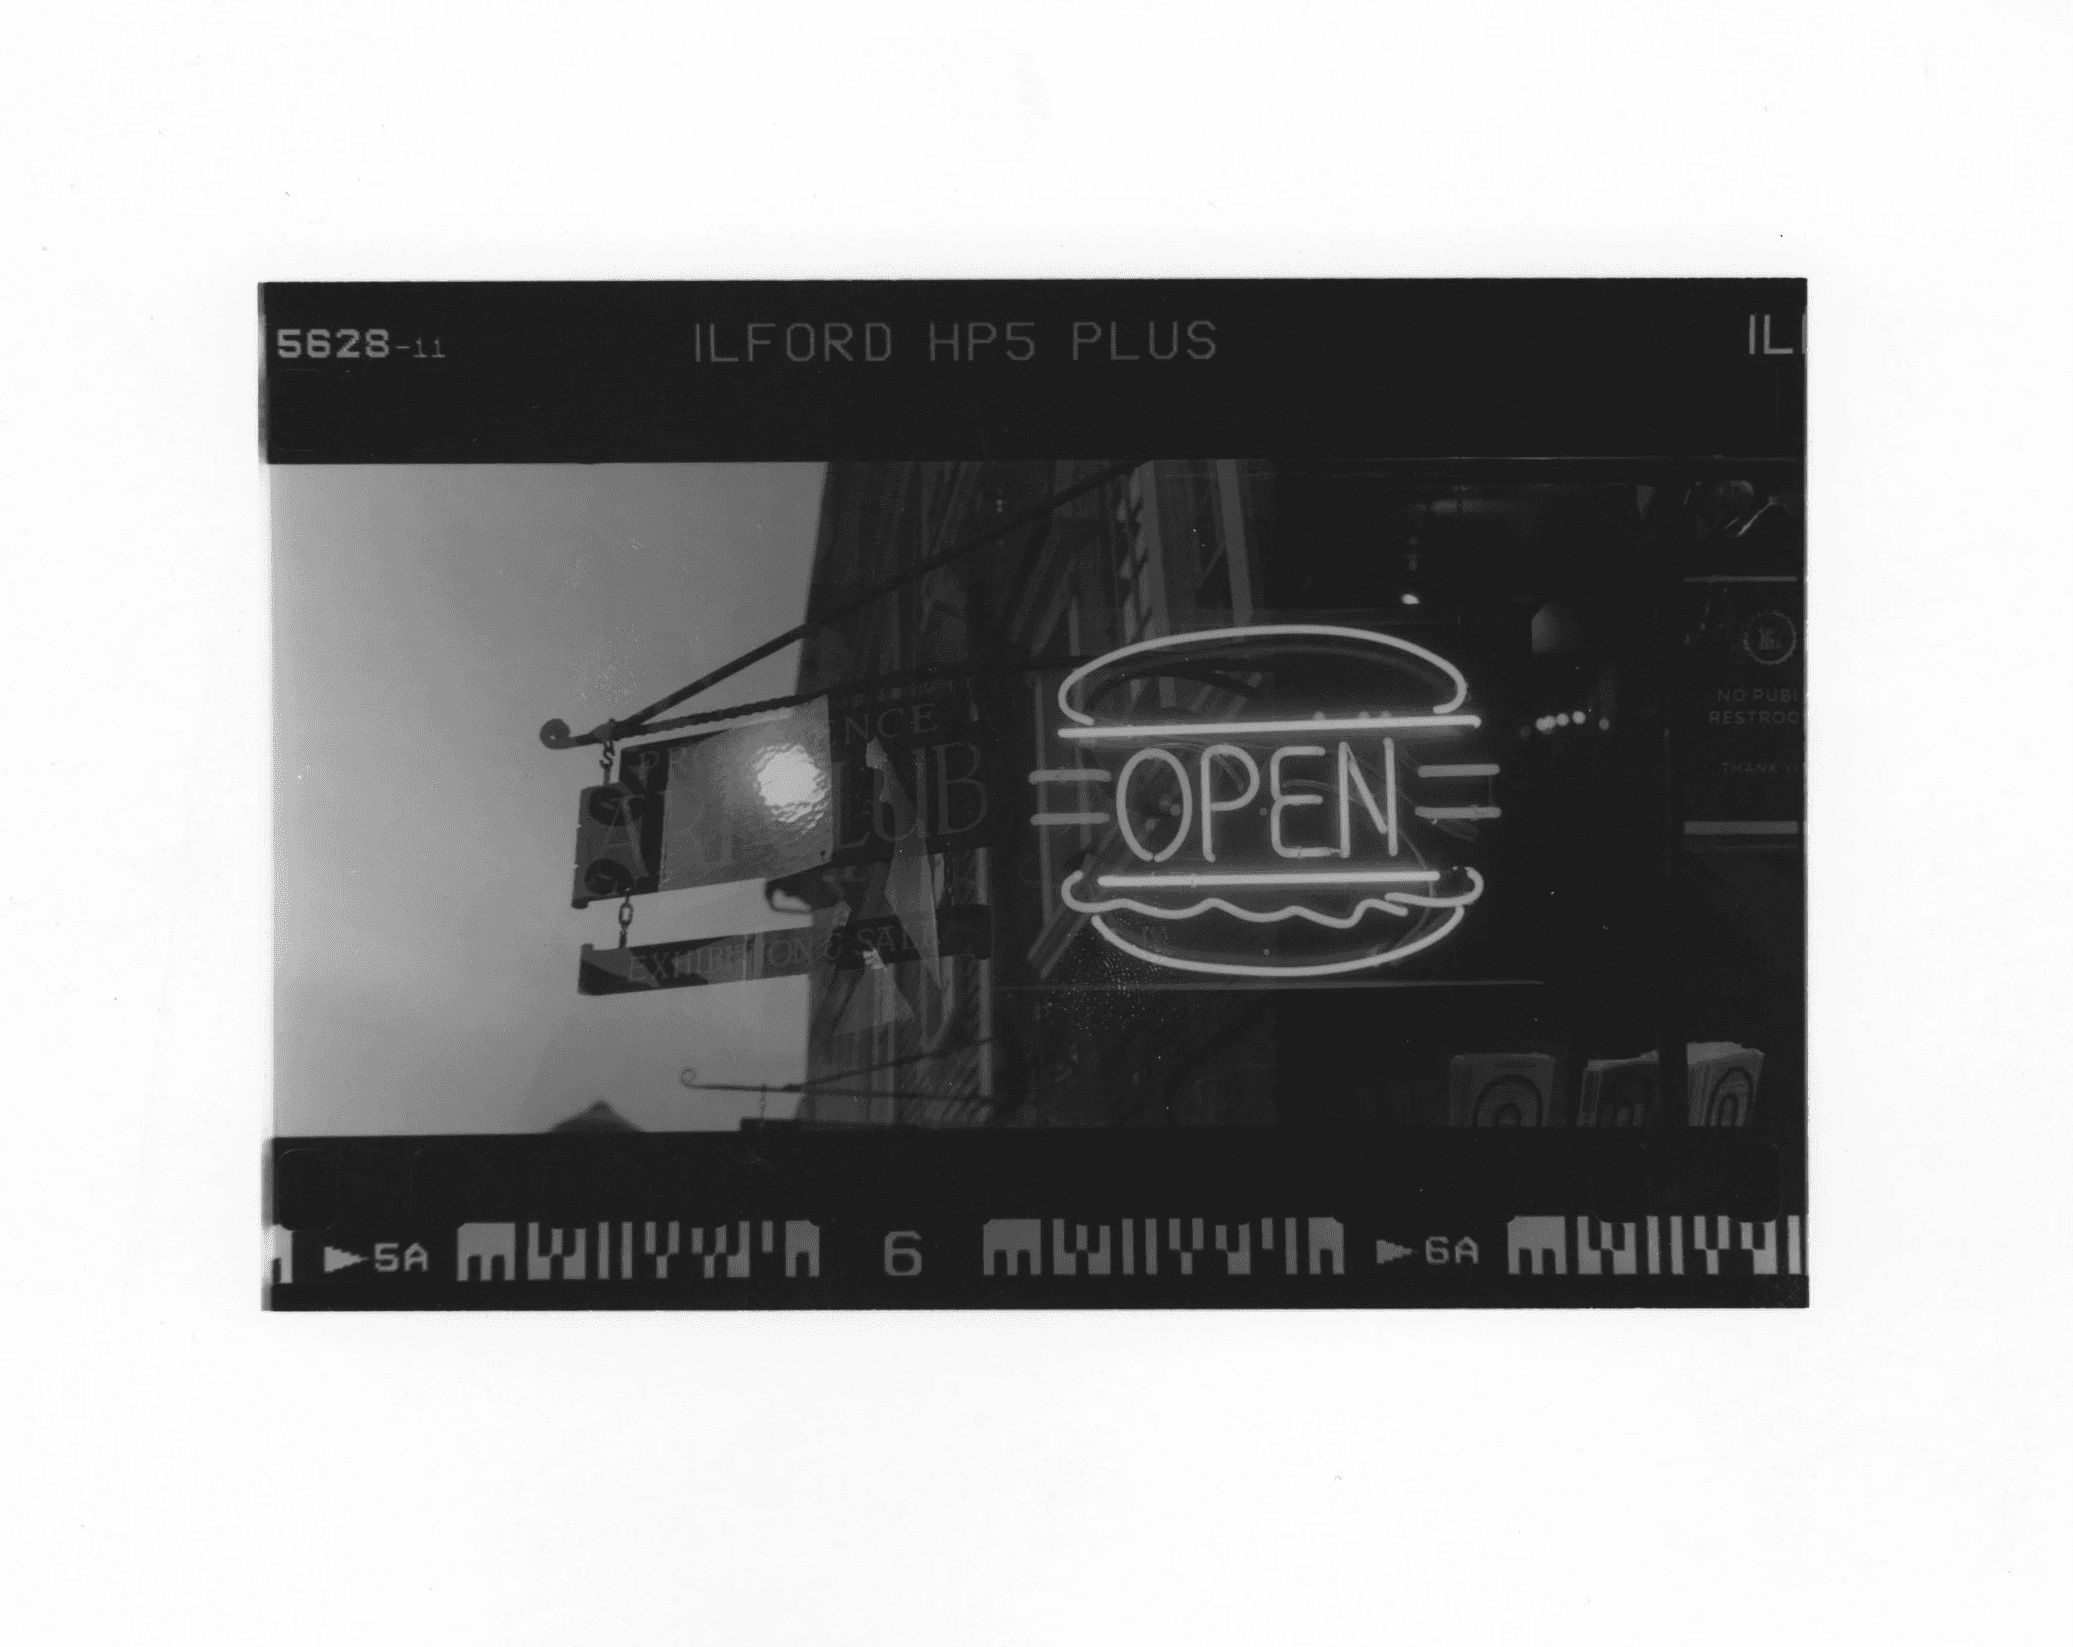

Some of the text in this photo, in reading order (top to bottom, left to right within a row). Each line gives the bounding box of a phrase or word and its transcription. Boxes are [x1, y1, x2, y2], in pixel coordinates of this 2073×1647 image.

[276, 328, 447, 360] 5628-11
[695, 320, 1217, 362] ILFORD HP5 PLUS
[1748, 313, 1806, 355] IL
[1717, 688, 1747, 702] NO
[1721, 761, 1777, 774] THANK
[1115, 737, 1399, 863] OPEN
[375, 1242, 429, 1273] 5A
[883, 1231, 923, 1277] 6
[1424, 1236, 1480, 1265] 6A
